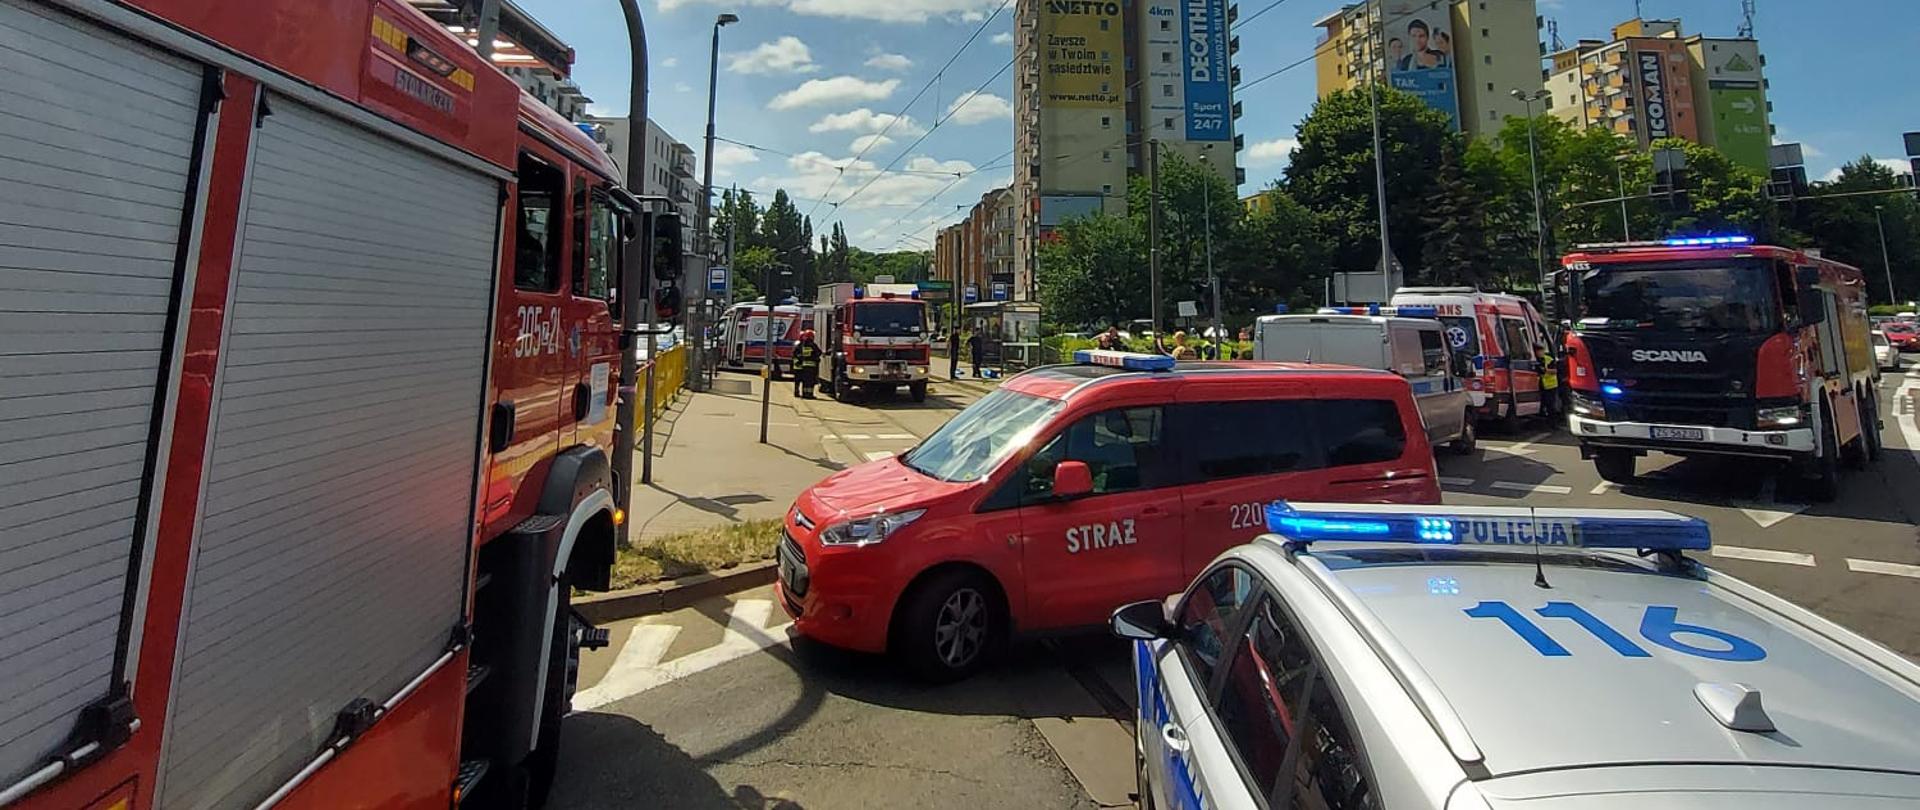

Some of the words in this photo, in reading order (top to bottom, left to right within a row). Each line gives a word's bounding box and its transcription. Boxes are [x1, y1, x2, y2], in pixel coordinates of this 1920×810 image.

[1050, 0, 1119, 16] NETTO
[1048, 34, 1087, 46] Zawsze
[1061, 48, 1096, 60] Twoim
[1049, 93, 1119, 103] www.netto.pl
[1193, 119, 1223, 130] 24/7
[1631, 350, 1708, 363] SCANIA
[1455, 520, 1568, 545] POLICJA
[1463, 601, 1767, 662] 116
